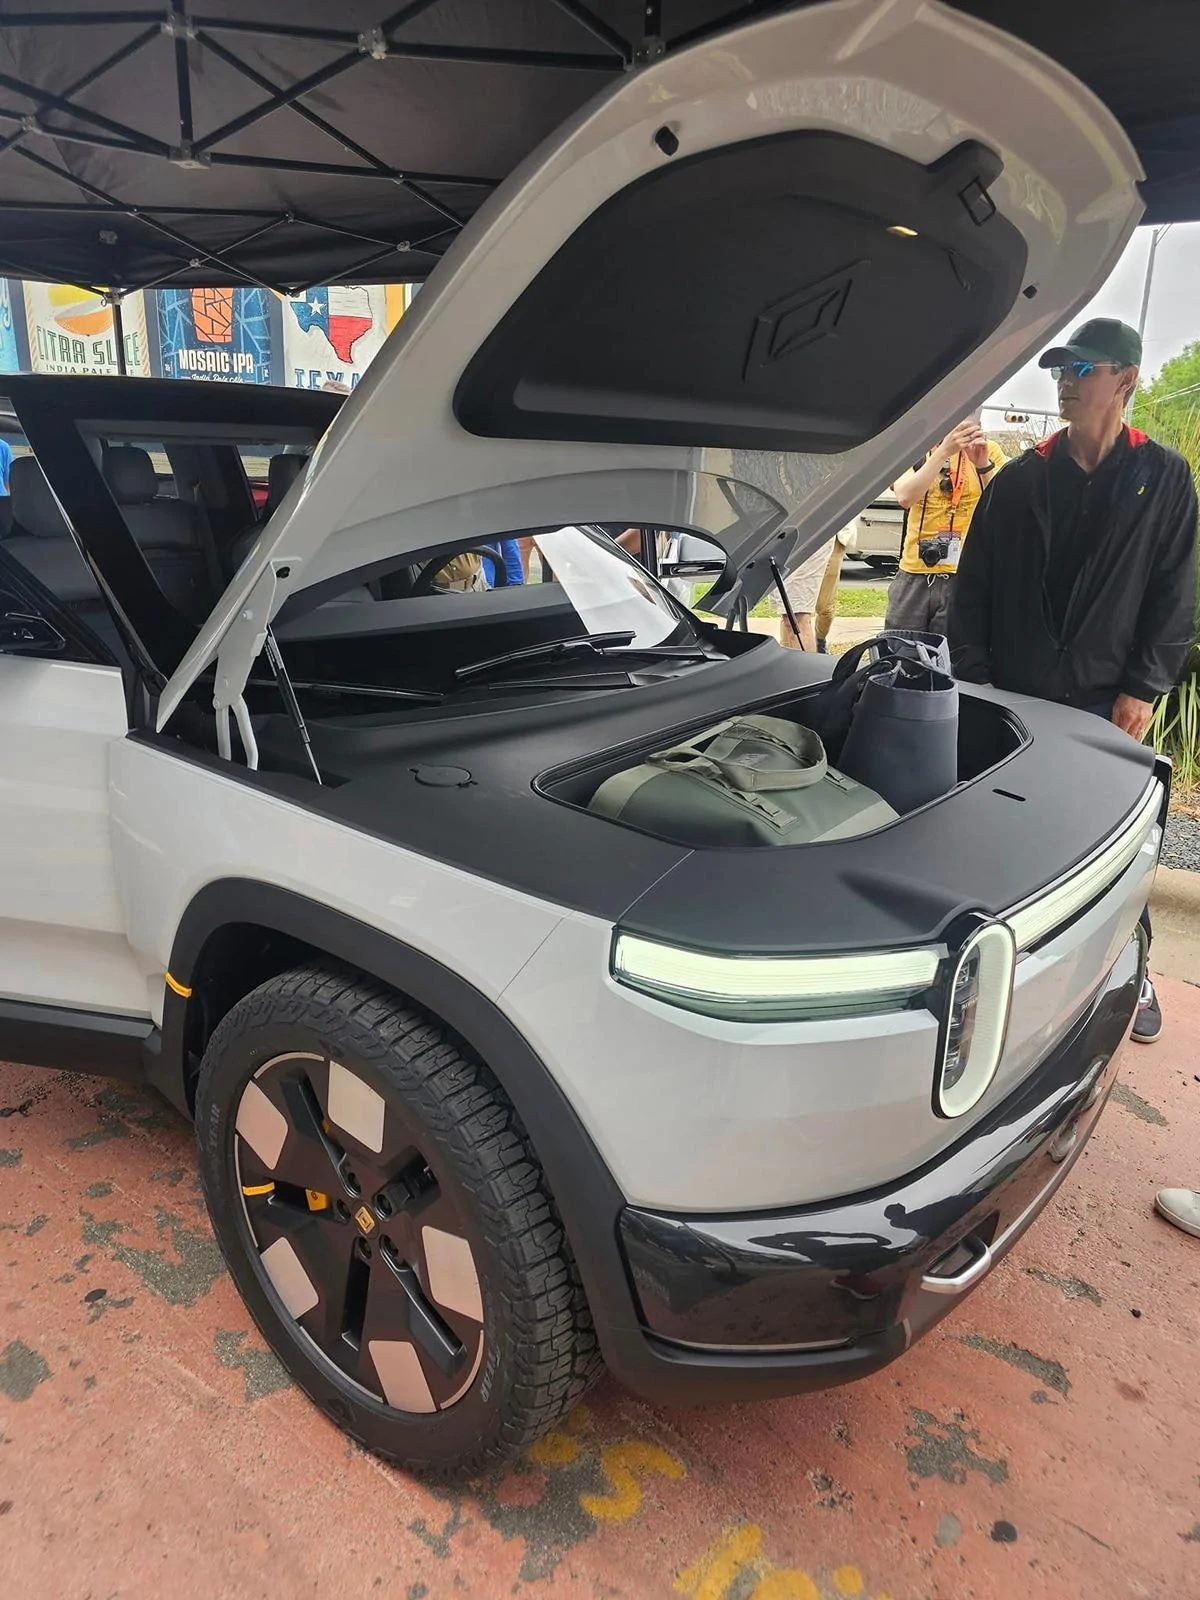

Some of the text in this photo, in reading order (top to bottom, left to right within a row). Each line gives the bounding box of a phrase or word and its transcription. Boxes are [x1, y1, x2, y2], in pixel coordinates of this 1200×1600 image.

[36, 325, 141, 367] CITRA SLCE
[46, 364, 77, 374] INDIA
[178, 348, 230, 374] MOSAIC
[232, 352, 255, 375] IPA
